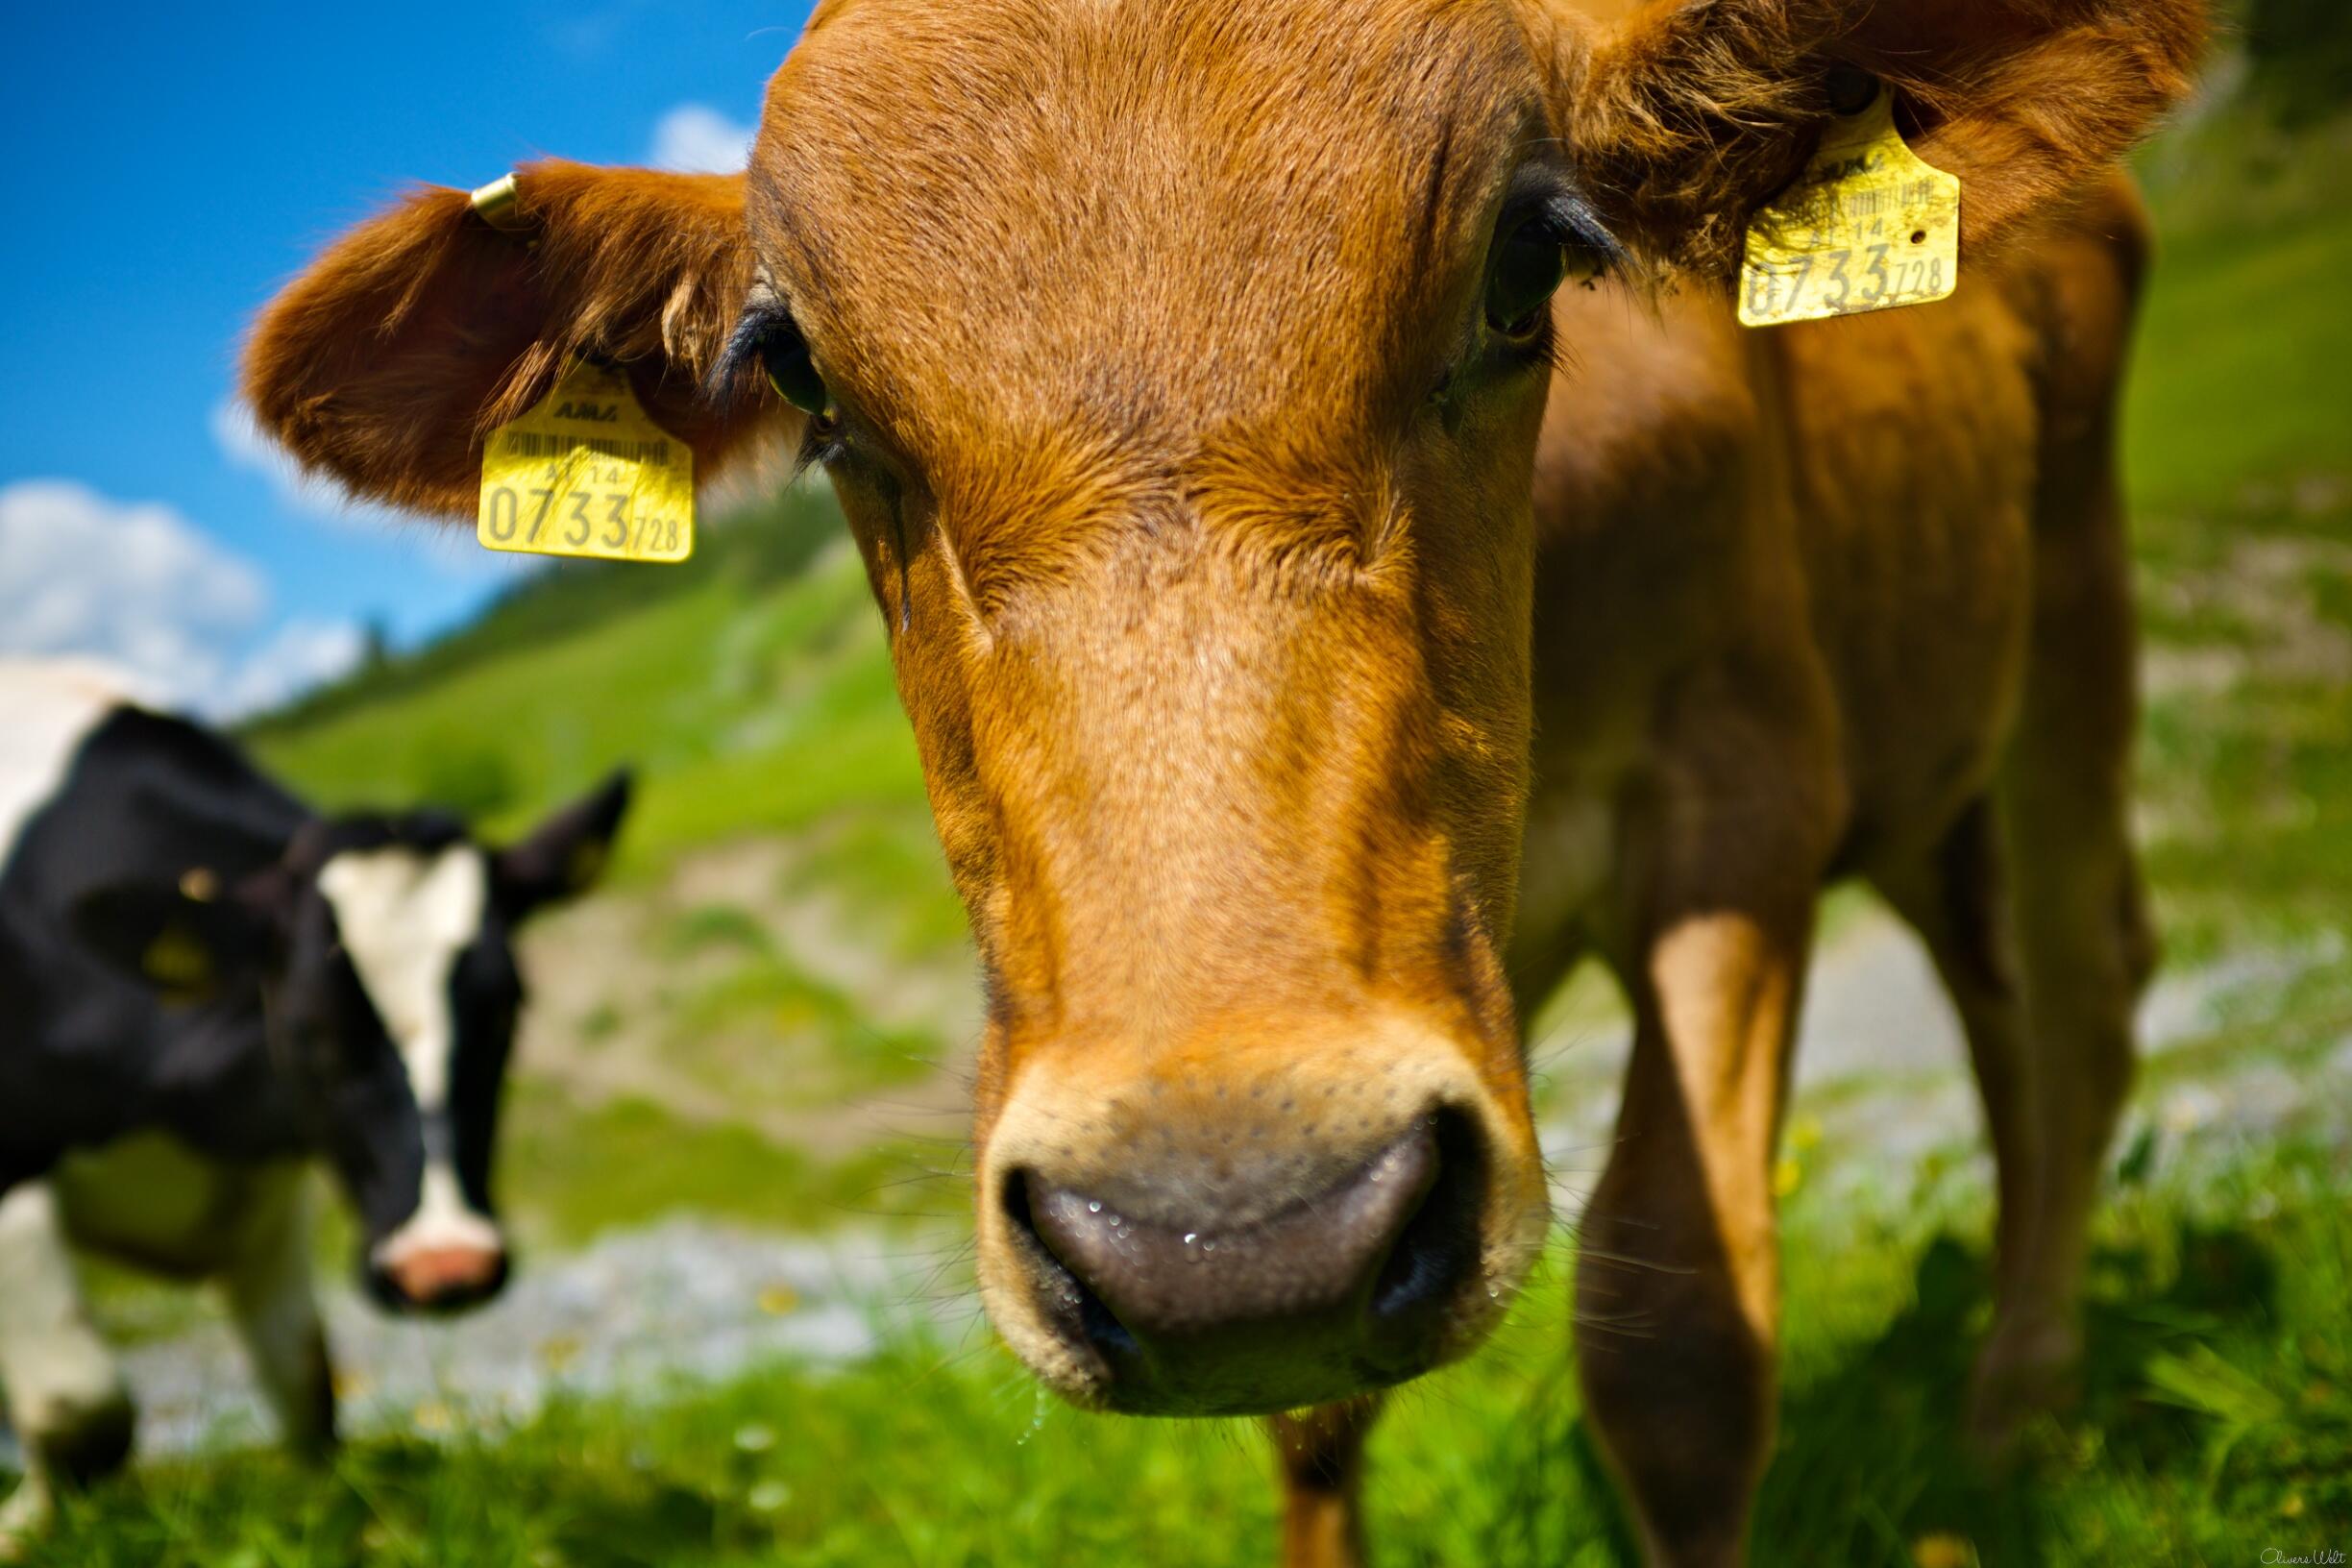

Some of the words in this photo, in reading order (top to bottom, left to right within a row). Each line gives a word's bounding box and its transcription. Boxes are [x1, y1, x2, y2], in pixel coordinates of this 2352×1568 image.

[1853, 217, 1884, 240] 14
[1746, 242, 1890, 316] 0733
[1895, 257, 1943, 294] 728
[590, 465, 619, 484] 14
[488, 486, 630, 549] 0733
[633, 516, 678, 552] 728
